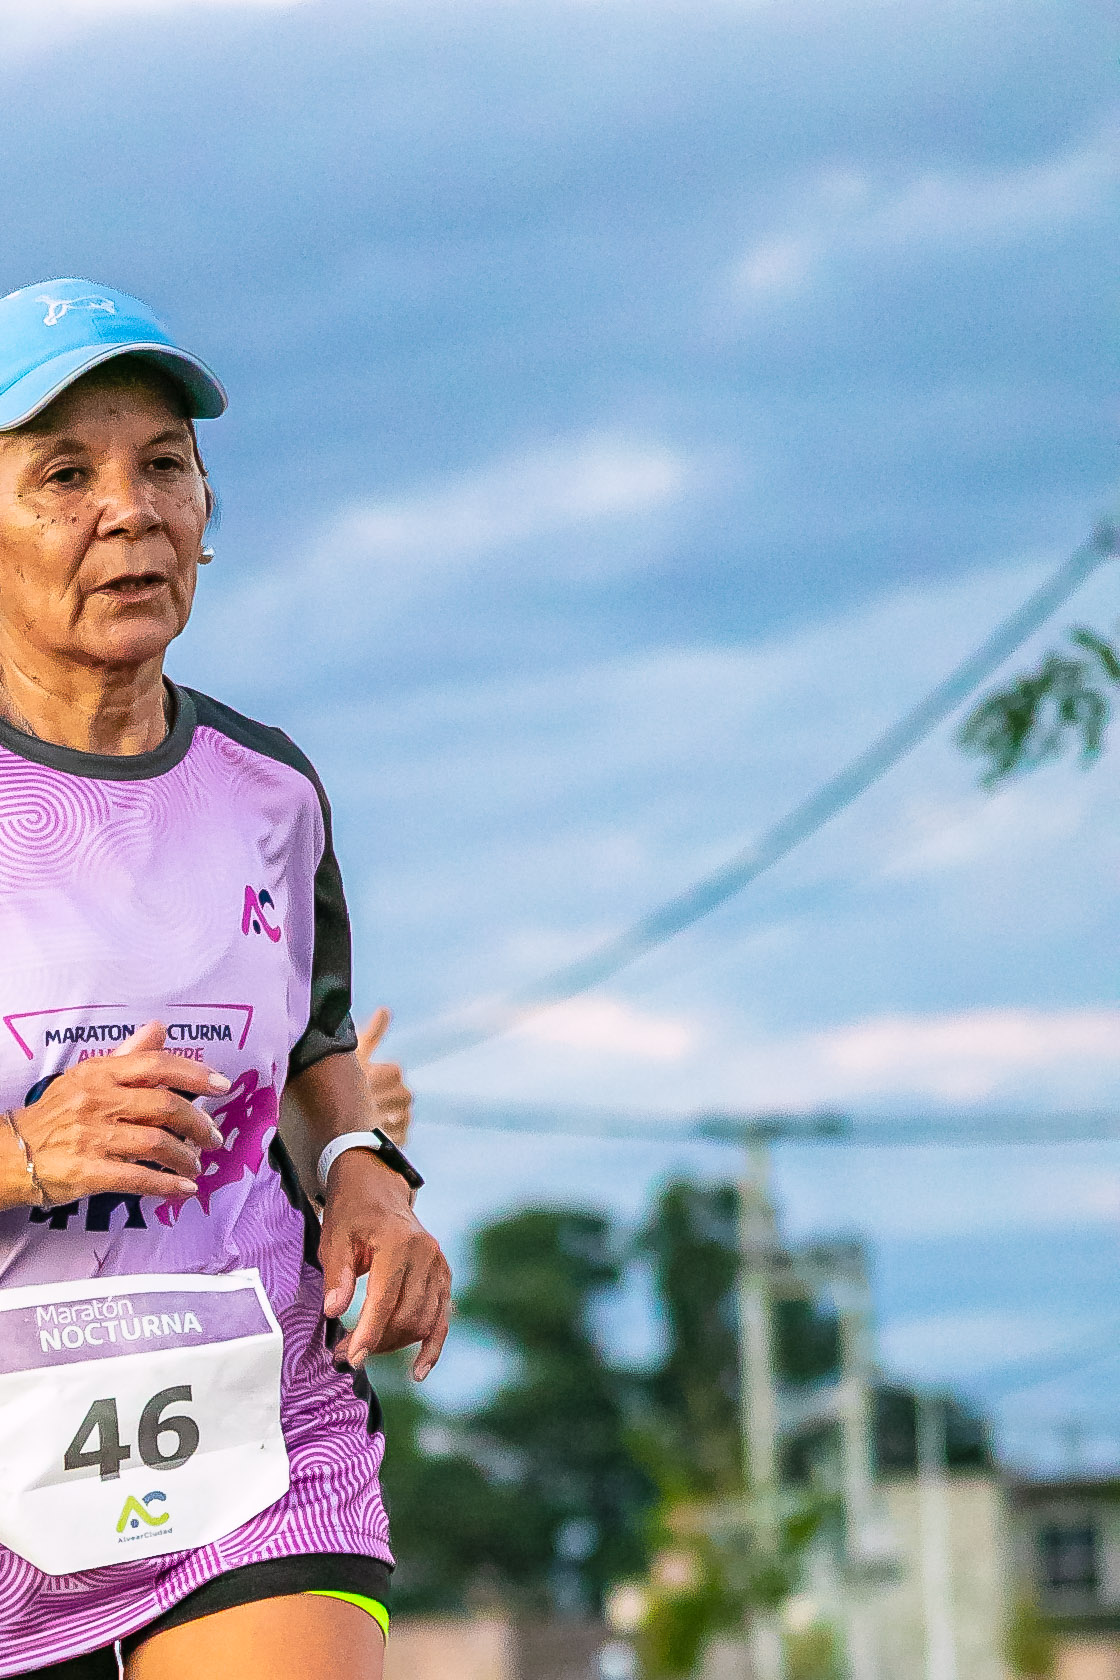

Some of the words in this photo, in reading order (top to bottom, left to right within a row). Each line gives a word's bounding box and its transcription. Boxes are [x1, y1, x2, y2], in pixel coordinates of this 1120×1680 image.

[45, 1024, 135, 1047] MARATON
[142, 1023, 233, 1042] CTURNA
[36, 1296, 134, 1328] Maratón
[39, 1311, 204, 1353] NOCTURNA
[63, 1384, 200, 1482] 46
